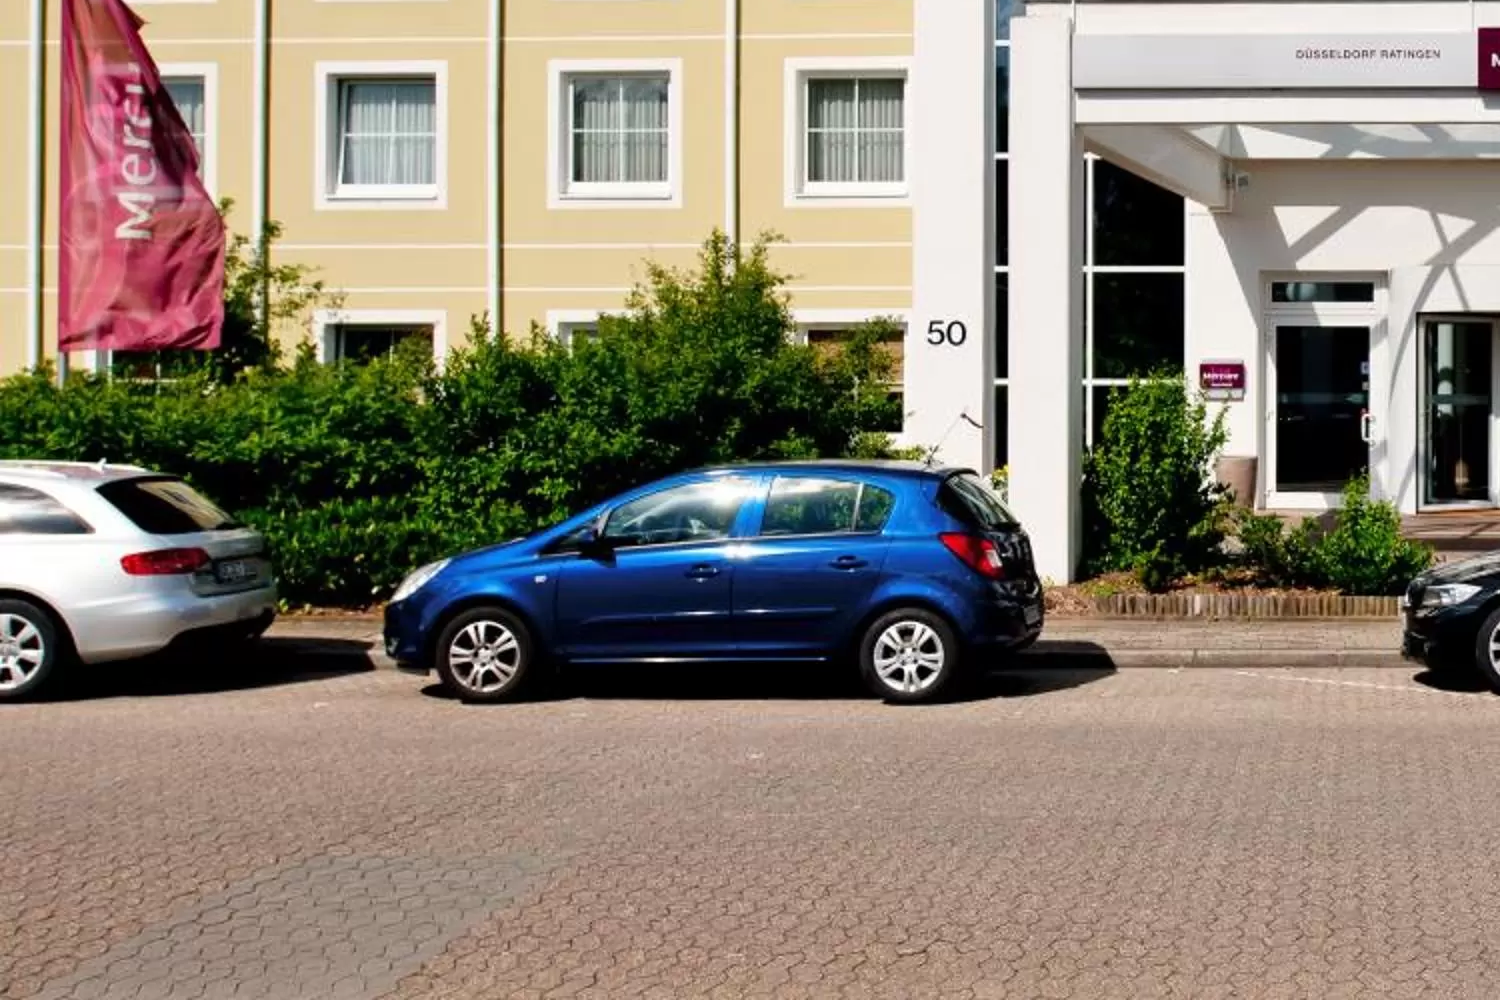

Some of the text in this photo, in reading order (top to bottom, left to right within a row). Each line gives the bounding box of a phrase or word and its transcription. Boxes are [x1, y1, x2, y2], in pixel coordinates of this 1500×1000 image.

[1295, 48, 1441, 60] DÜSSELDORF RATINGEN
[927, 320, 967, 346] 50
